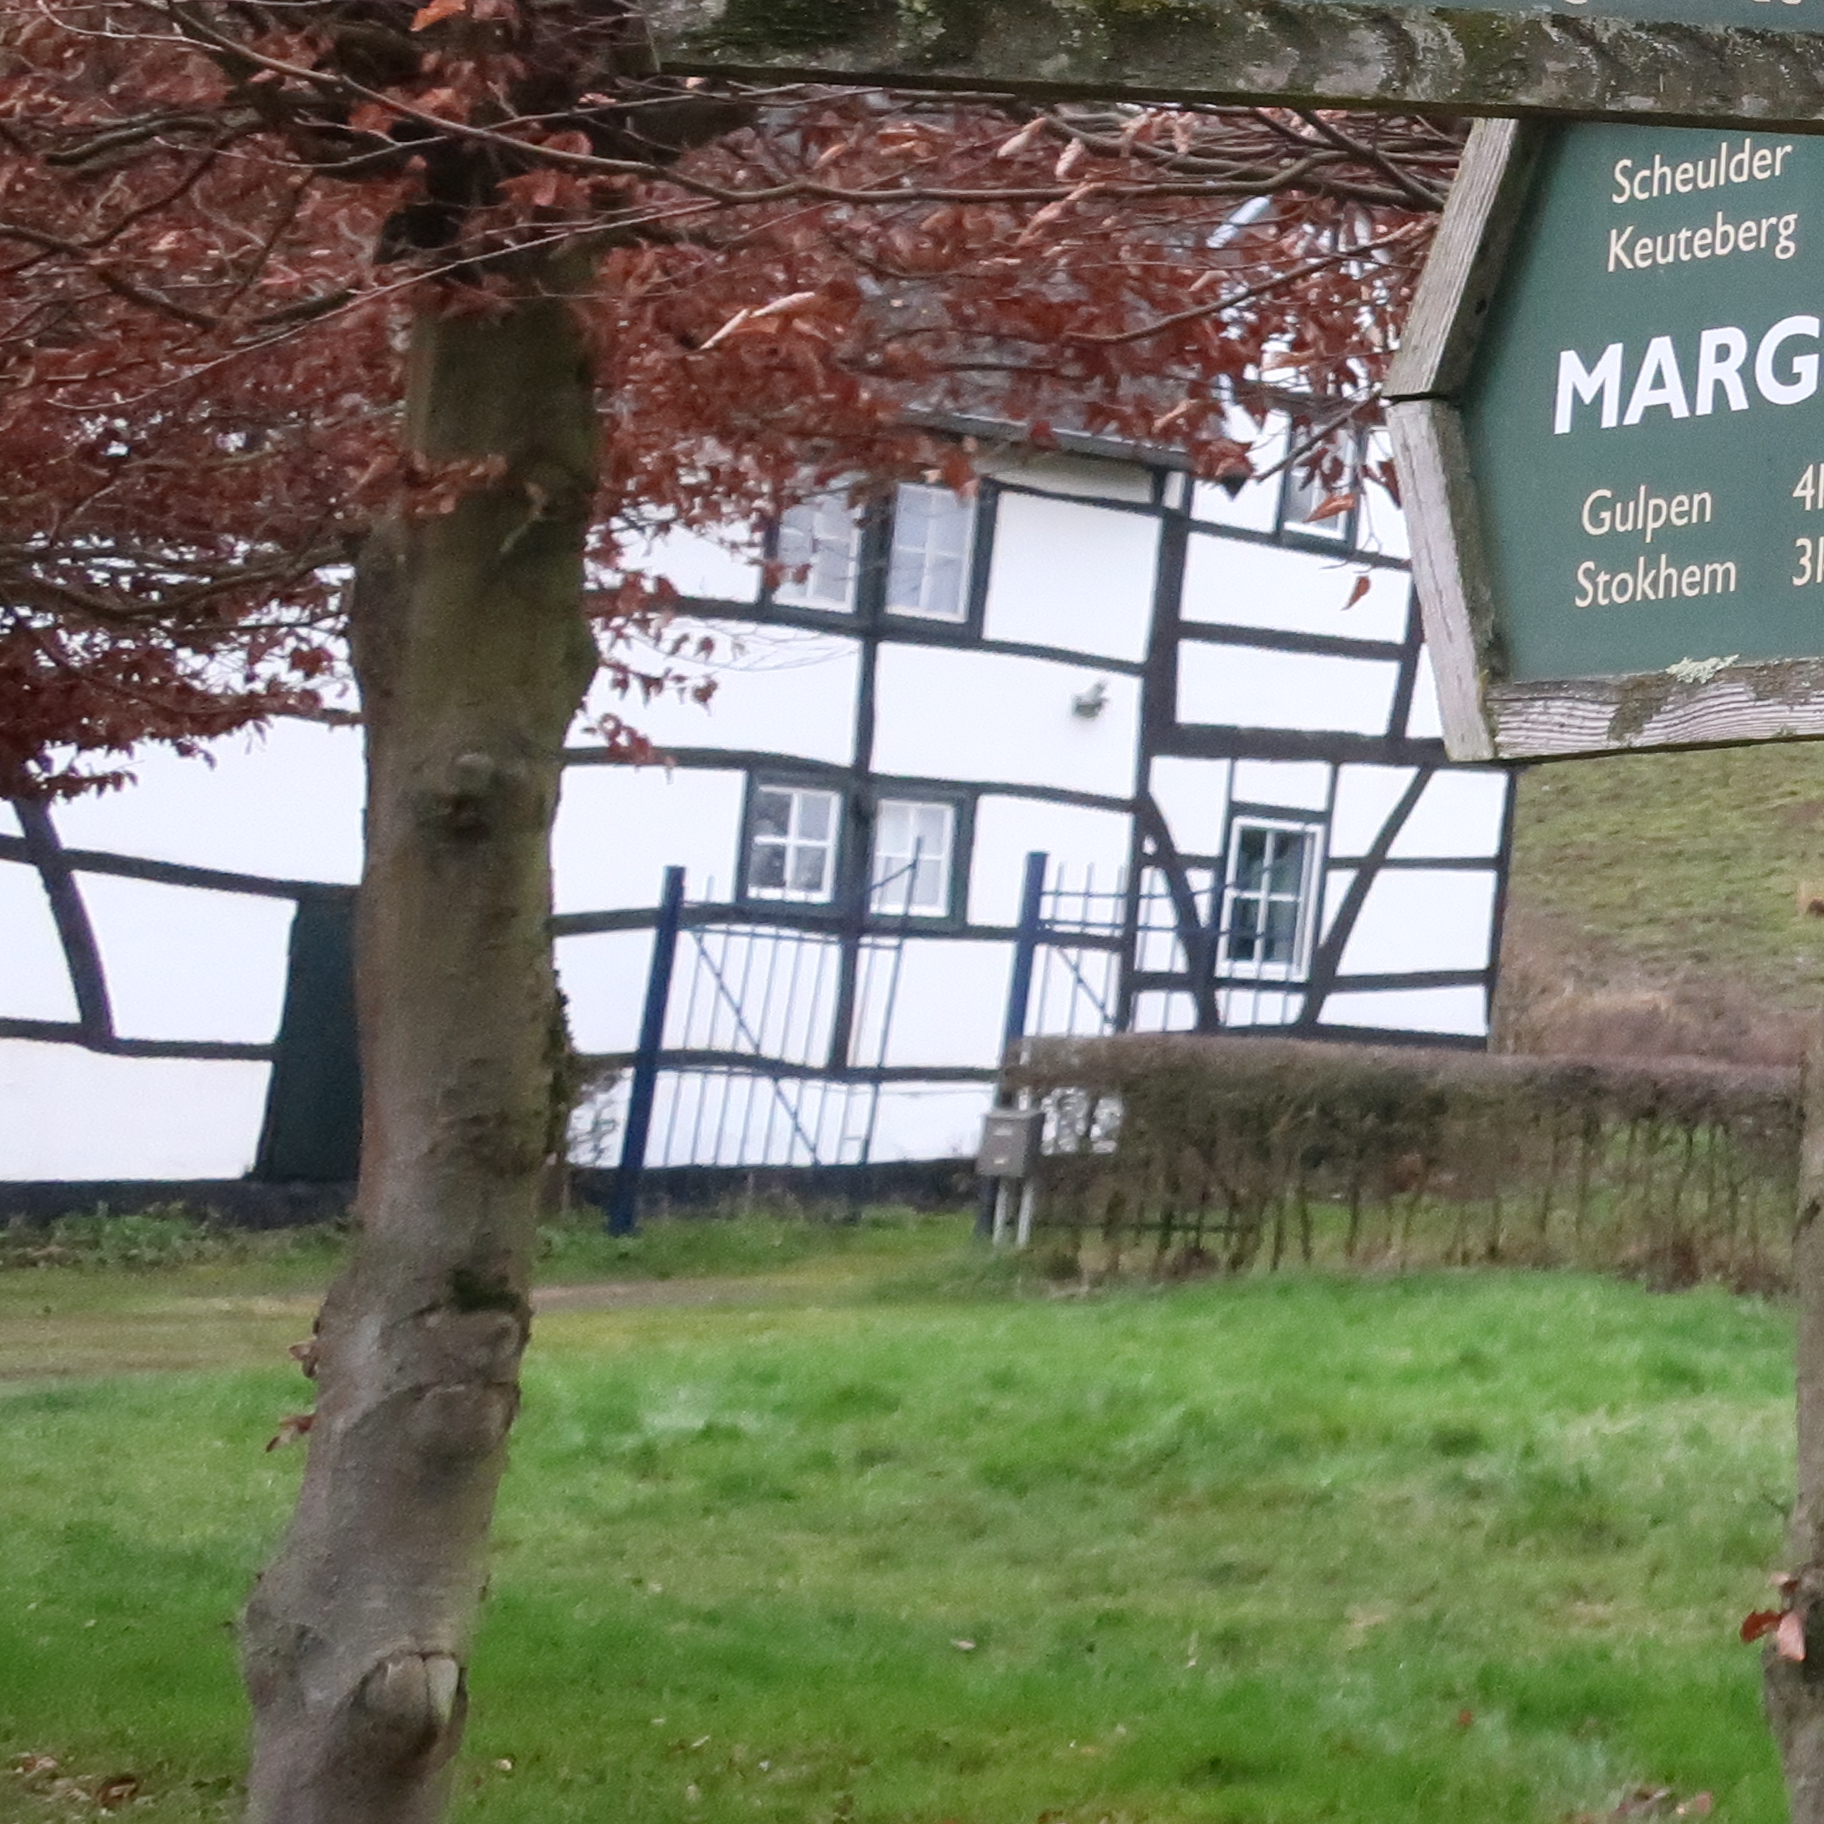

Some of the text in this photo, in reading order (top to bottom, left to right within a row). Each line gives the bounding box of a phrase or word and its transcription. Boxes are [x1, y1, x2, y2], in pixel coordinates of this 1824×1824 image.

[1611, 137, 1794, 204] Scheulder
[1607, 210, 1799, 273] Keuteberg
[1581, 483, 1712, 544] Gulpen
[1574, 553, 1737, 608] Stokhem
